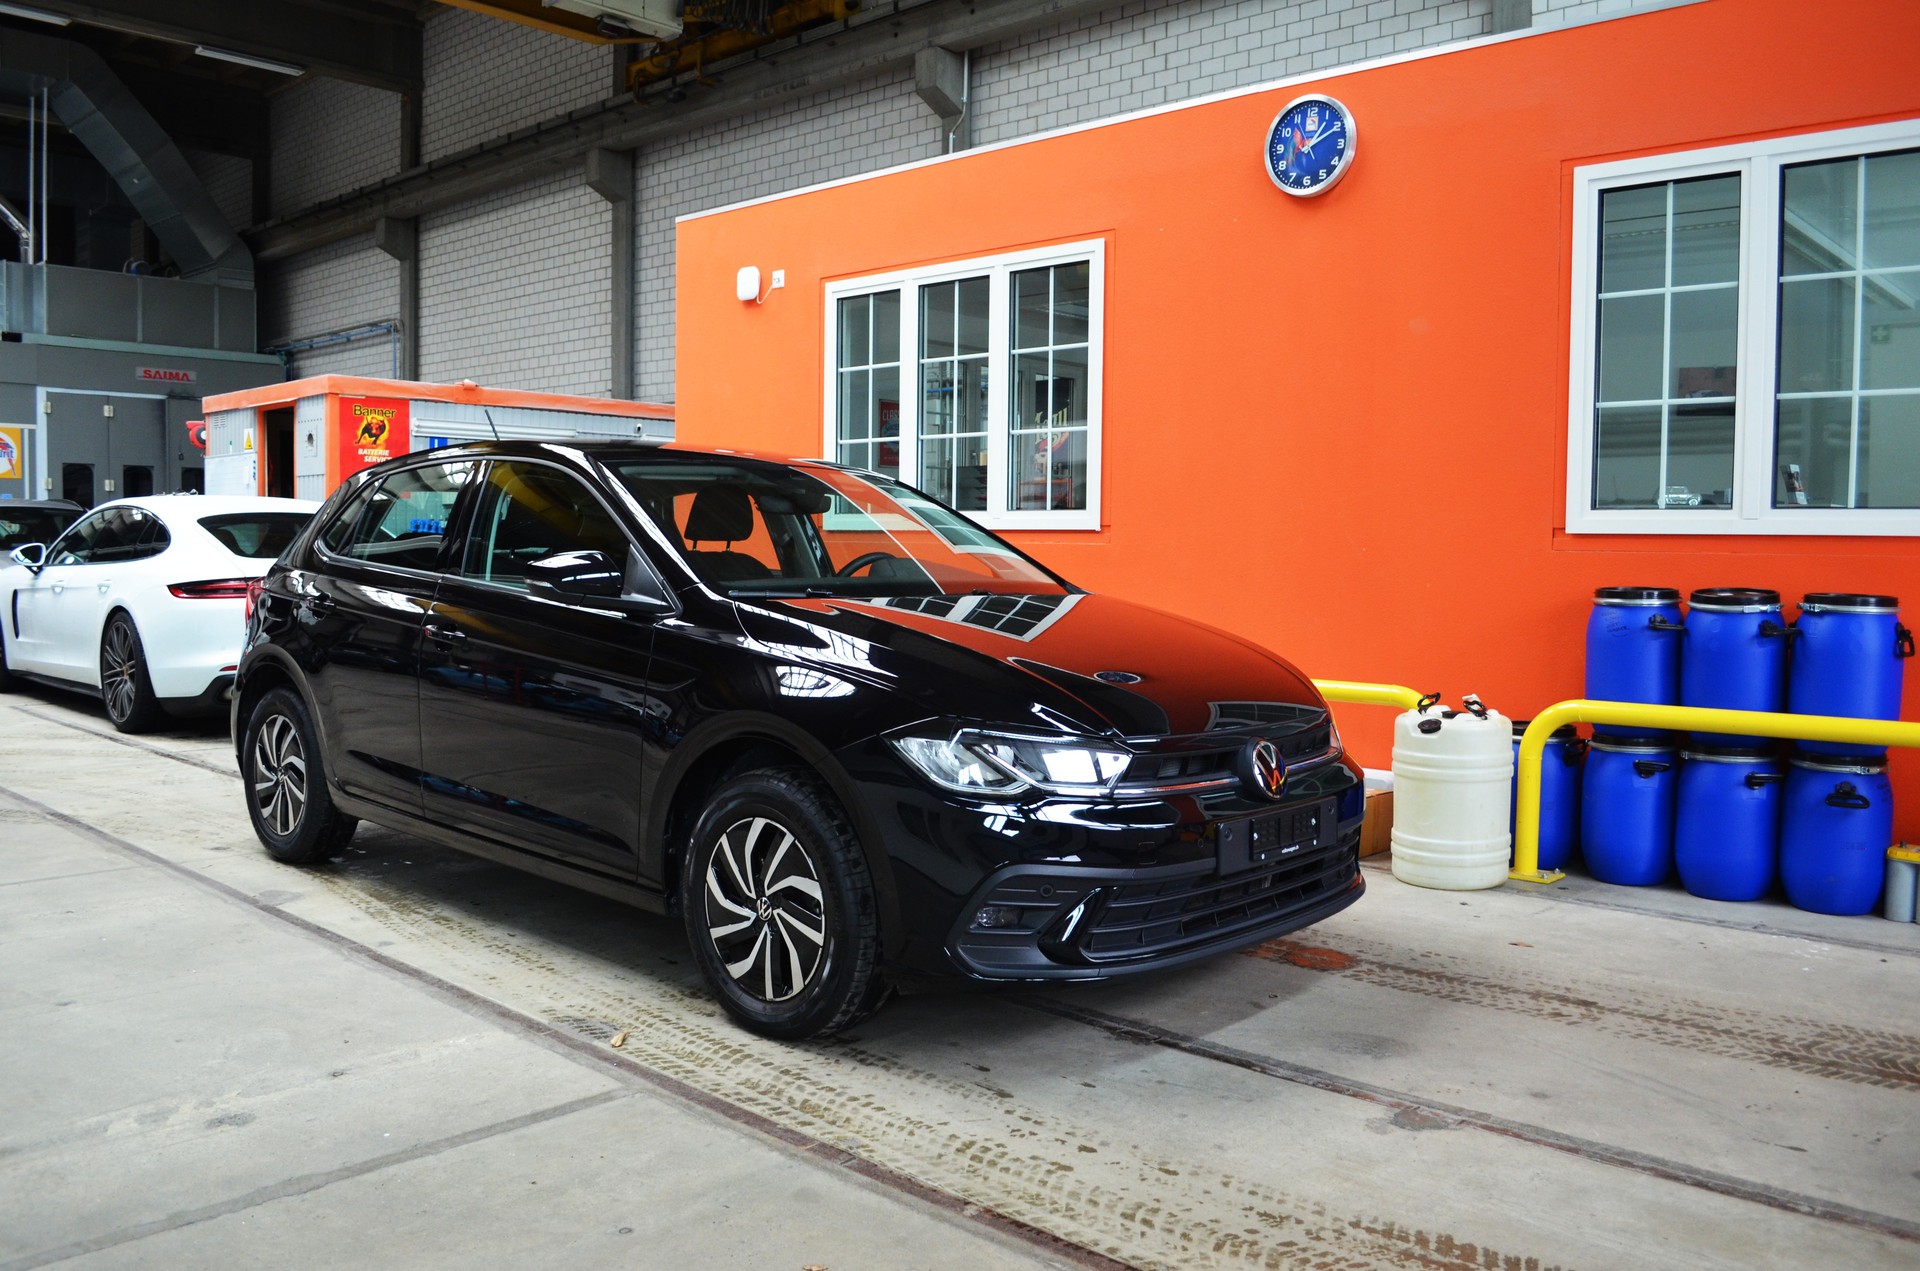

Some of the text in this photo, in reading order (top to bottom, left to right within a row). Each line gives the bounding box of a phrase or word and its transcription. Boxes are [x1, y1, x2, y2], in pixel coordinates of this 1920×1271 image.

[1307, 107, 1318, 117] 12
[1326, 110, 1329, 120] 1
[1294, 114, 1301, 124] 11
[1334, 121, 1341, 131] 2
[1282, 128, 1291, 137] 10
[1276, 144, 1284, 154] 9
[1337, 139, 1345, 149] 3
[1279, 161, 1286, 170] 8
[1331, 156, 1339, 166] 4
[1289, 173, 1296, 182] 7
[1319, 170, 1326, 179] 5
[1303, 176, 1311, 186] 6
[143, 368, 191, 382] SAIMA
[353, 404, 396, 418] Banner
[358, 448, 390, 456] BATTERIE
